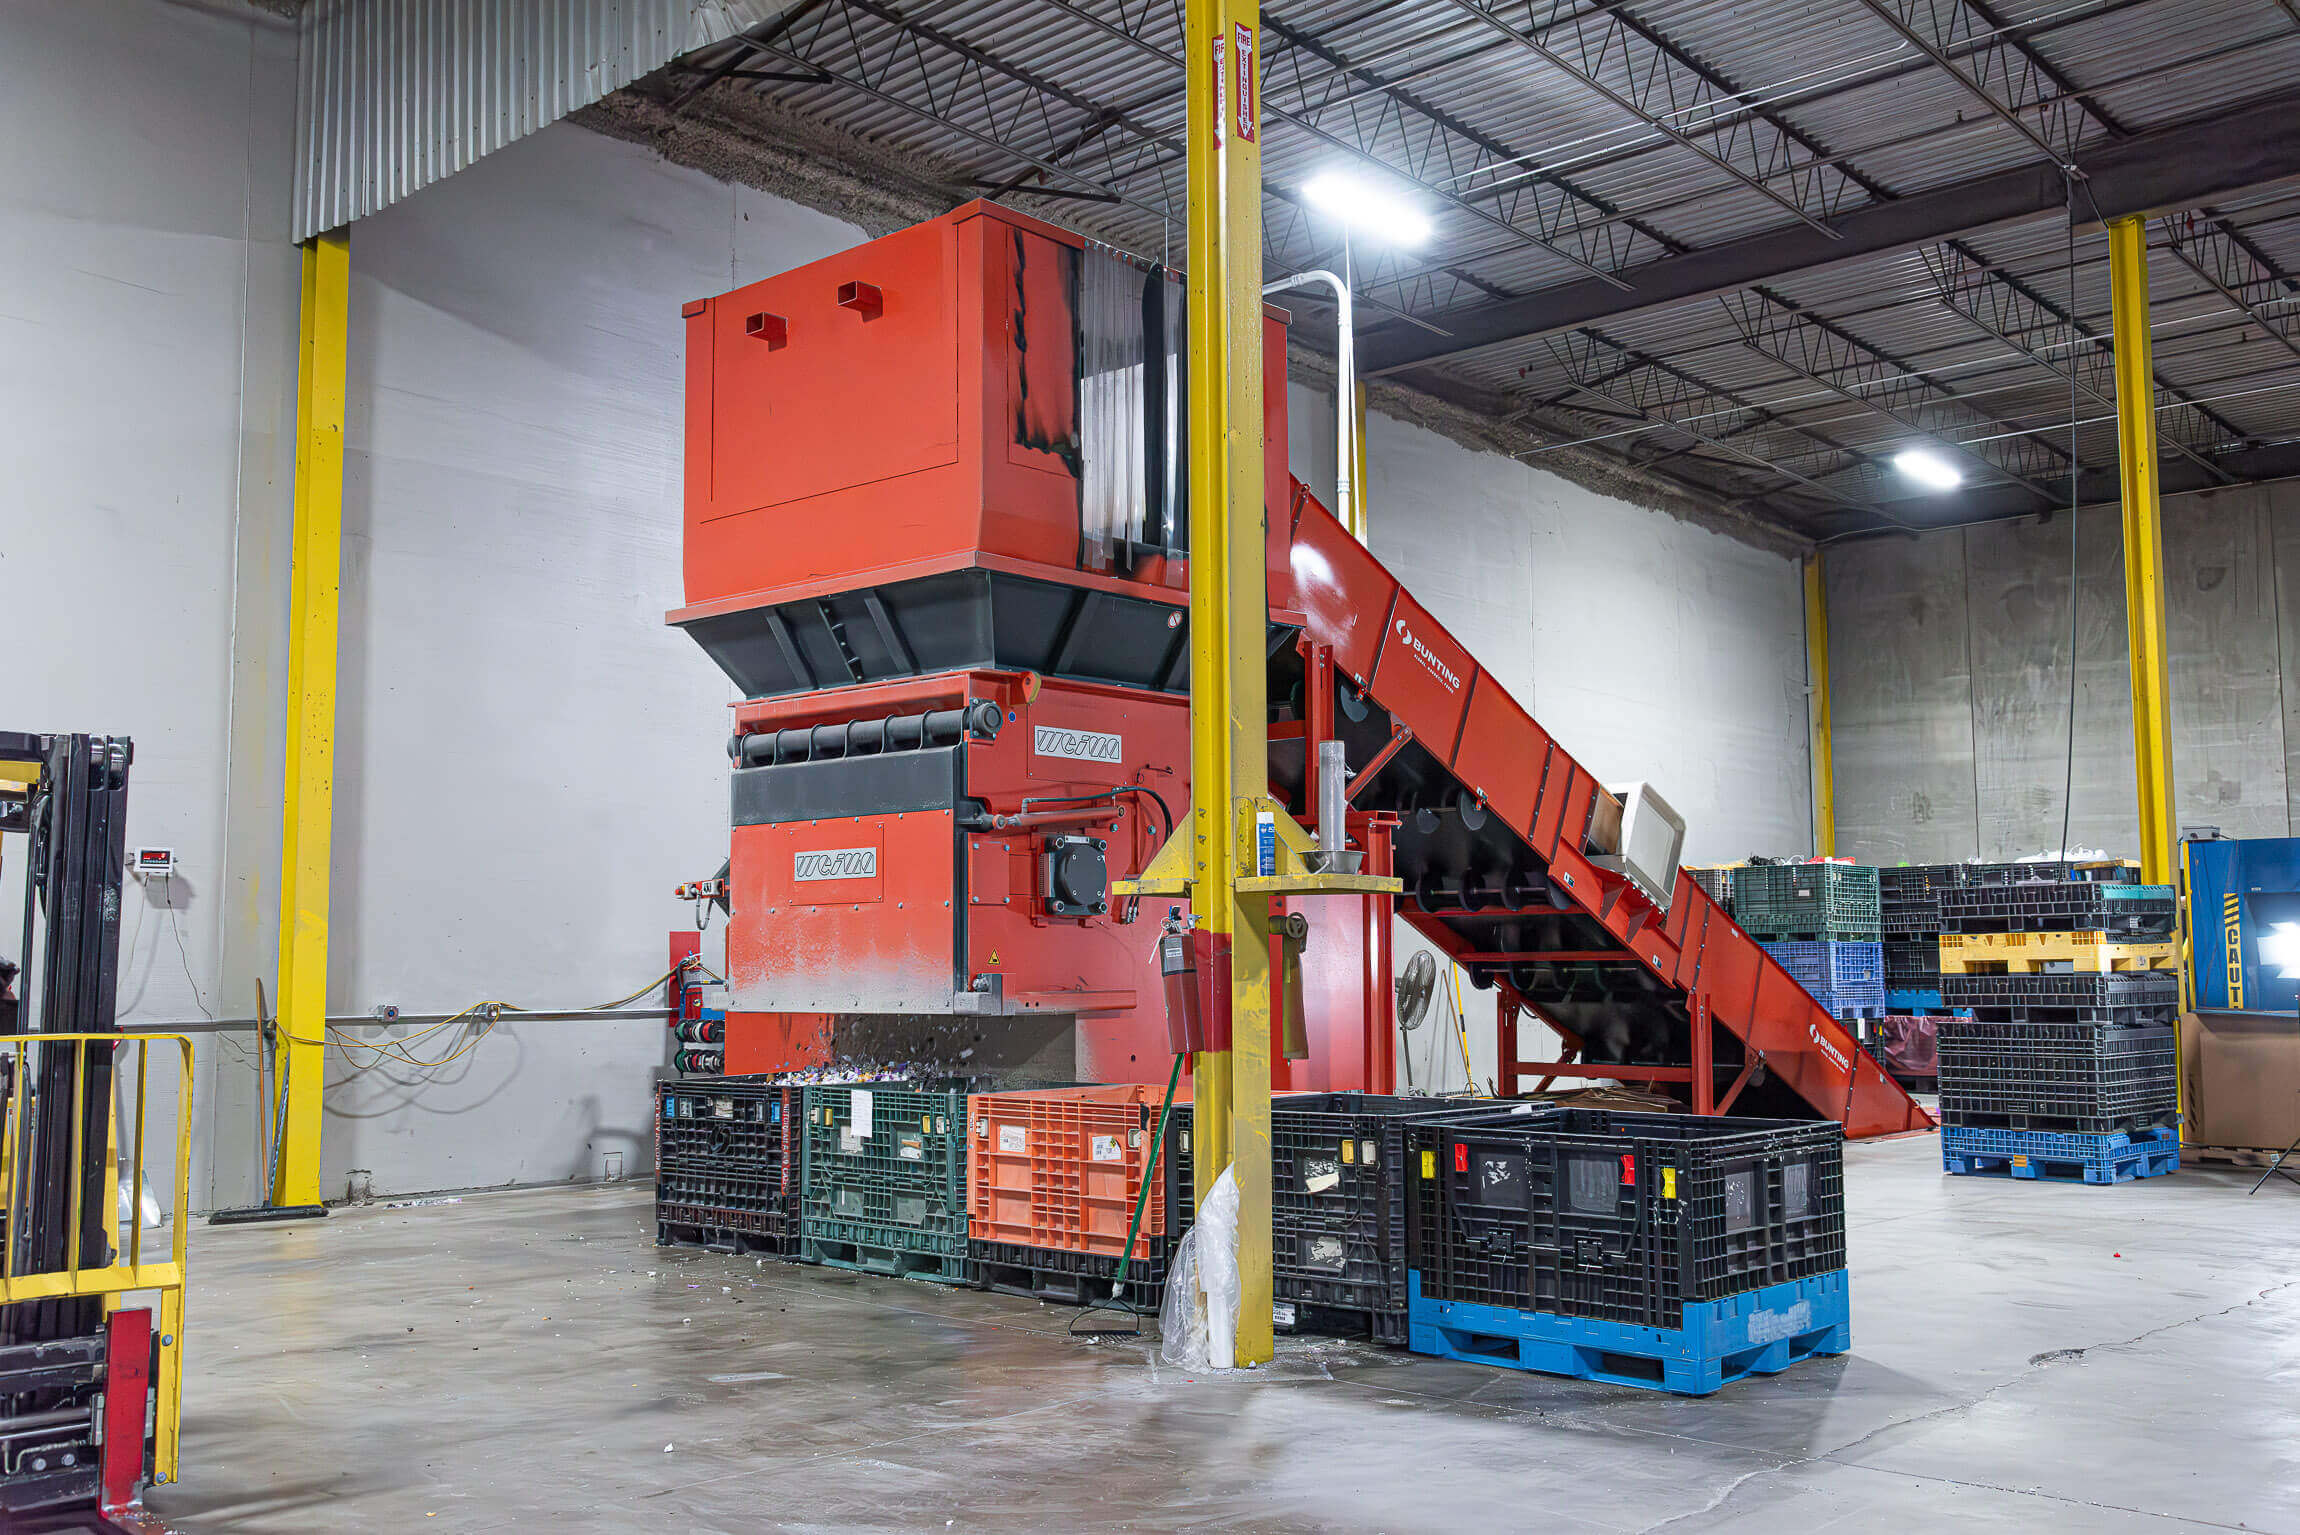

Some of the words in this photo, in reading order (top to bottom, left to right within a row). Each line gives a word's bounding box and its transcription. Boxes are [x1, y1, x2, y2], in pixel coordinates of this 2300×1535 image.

[1238, 32, 1251, 47] FIRE
[1413, 637, 1460, 689] BUNTING
[2228, 928, 2241, 1008] CAUT
[1820, 1035, 1849, 1069] BUNTING
